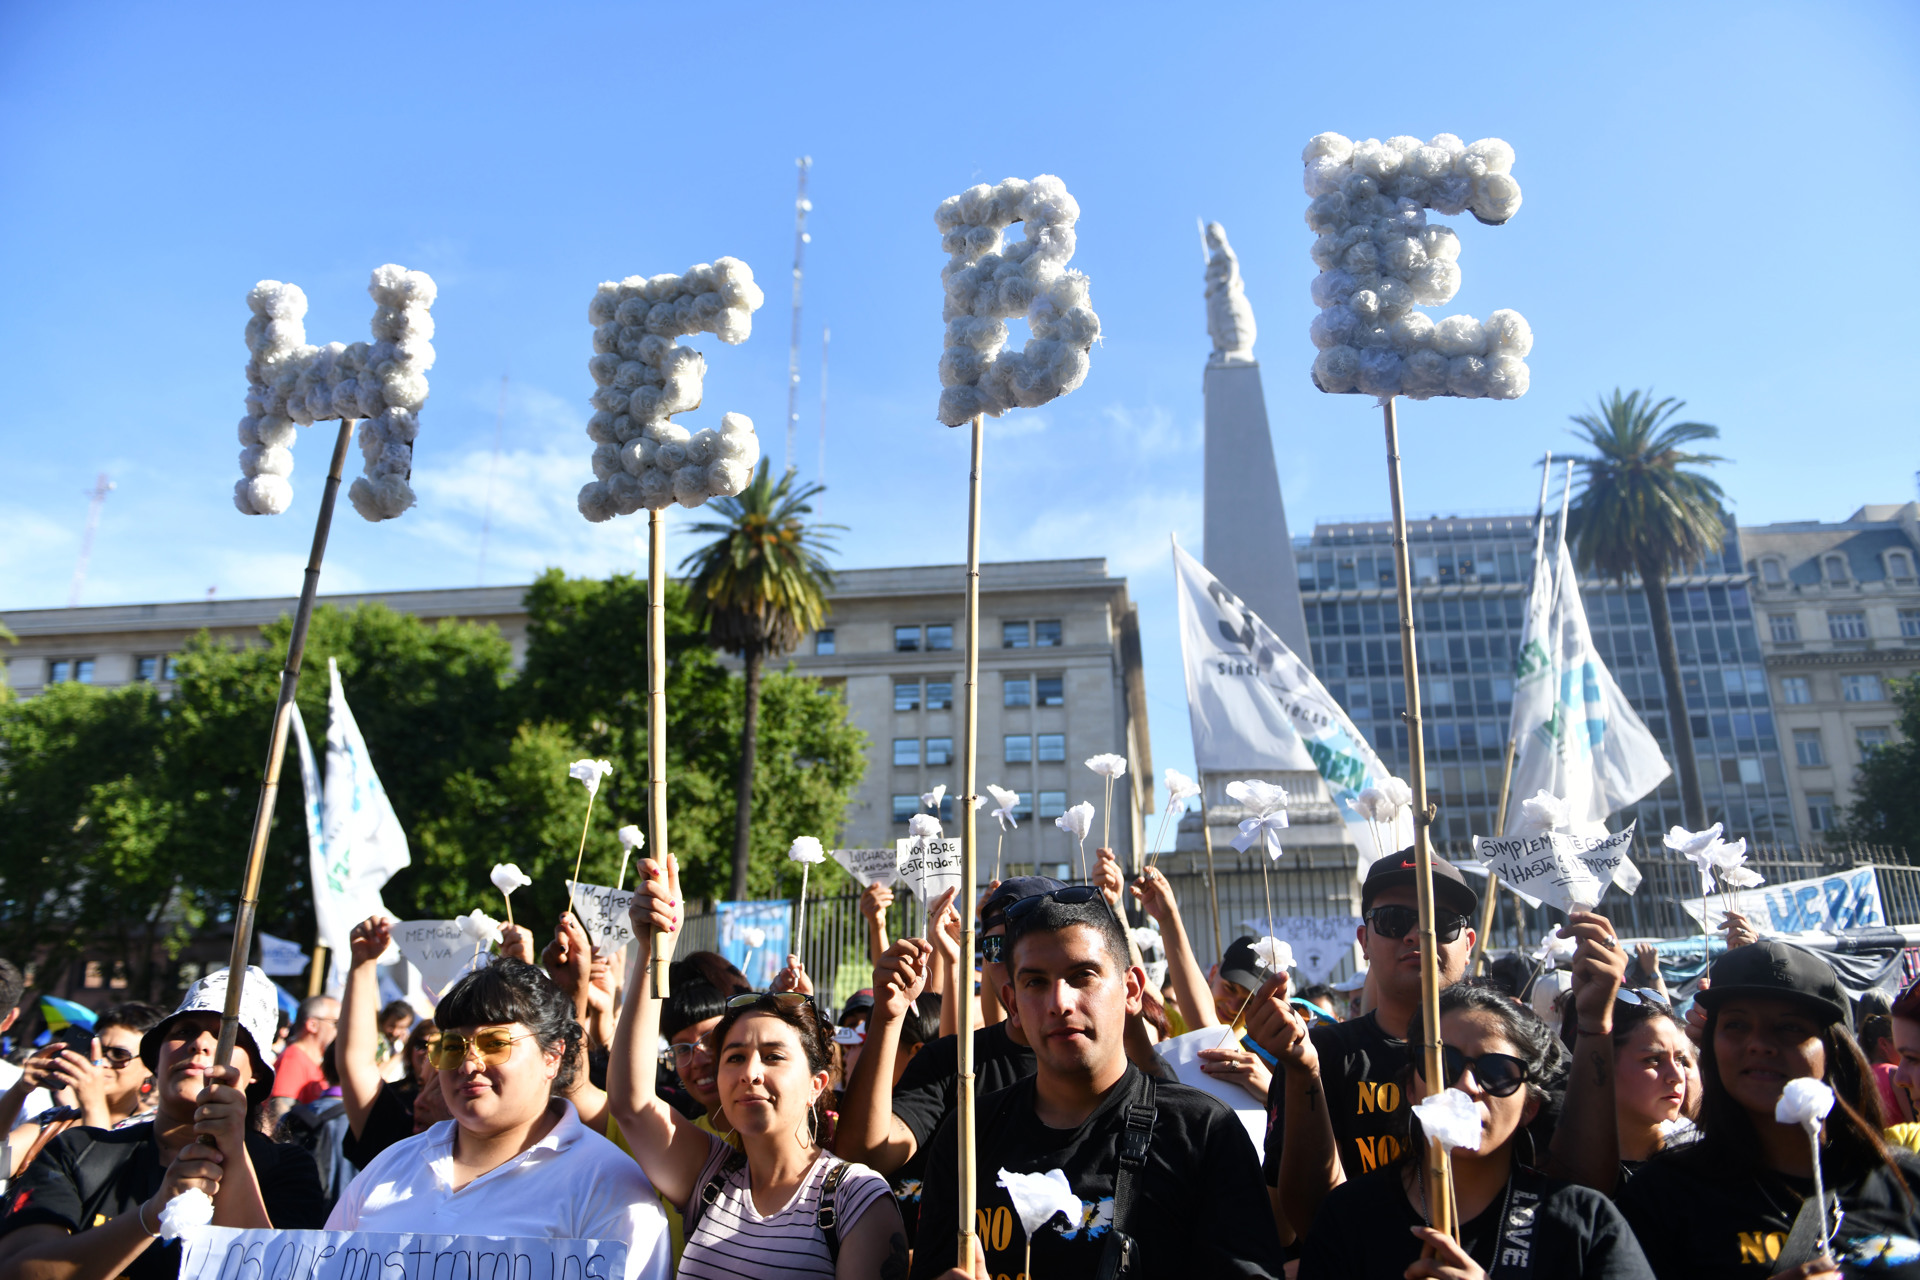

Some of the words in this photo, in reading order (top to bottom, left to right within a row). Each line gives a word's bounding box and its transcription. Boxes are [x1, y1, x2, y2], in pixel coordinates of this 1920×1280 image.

[1498, 862, 1509, 882] Y
[1511, 856, 1556, 885] HASTA
[1356, 1081, 1400, 1115] NO
[976, 1206, 1013, 1251] NO
[1502, 1190, 1538, 1267] LOVE
